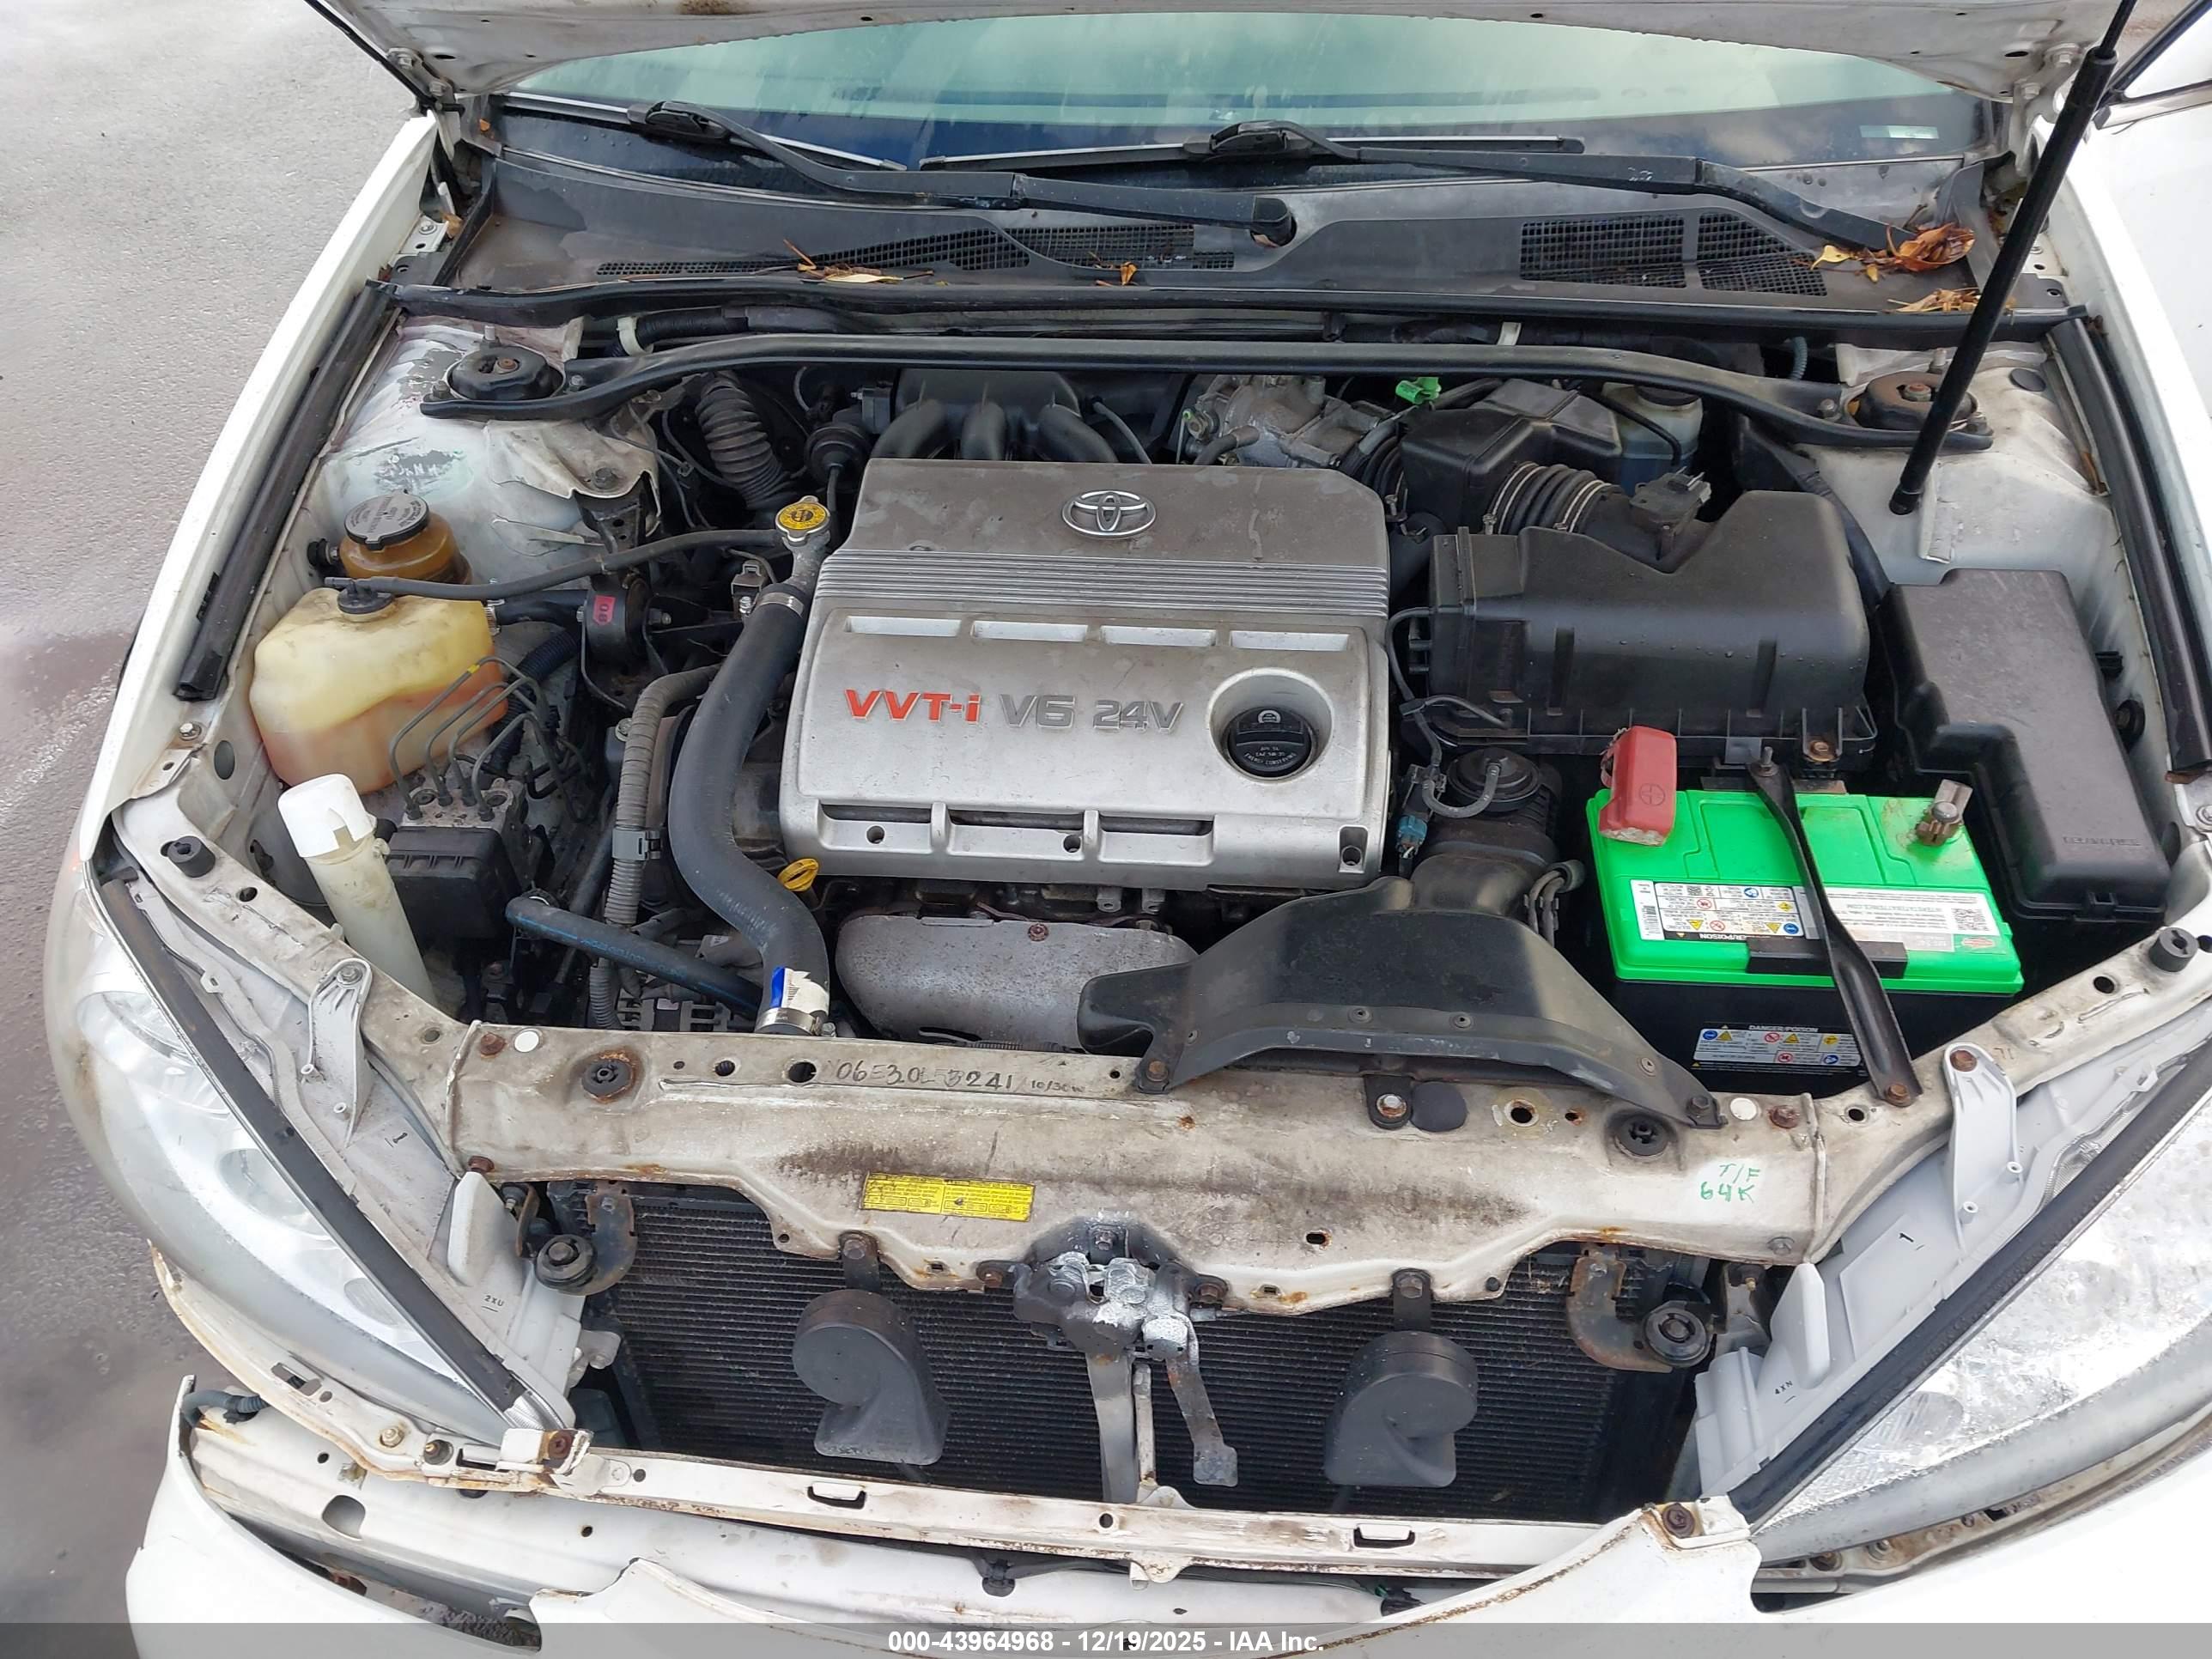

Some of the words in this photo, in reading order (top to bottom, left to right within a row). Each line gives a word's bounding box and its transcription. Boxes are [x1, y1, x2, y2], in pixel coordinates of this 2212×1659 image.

[844, 689, 981, 725] VVT-i
[999, 694, 1077, 729] V6
[1092, 699, 1185, 733] 24V
